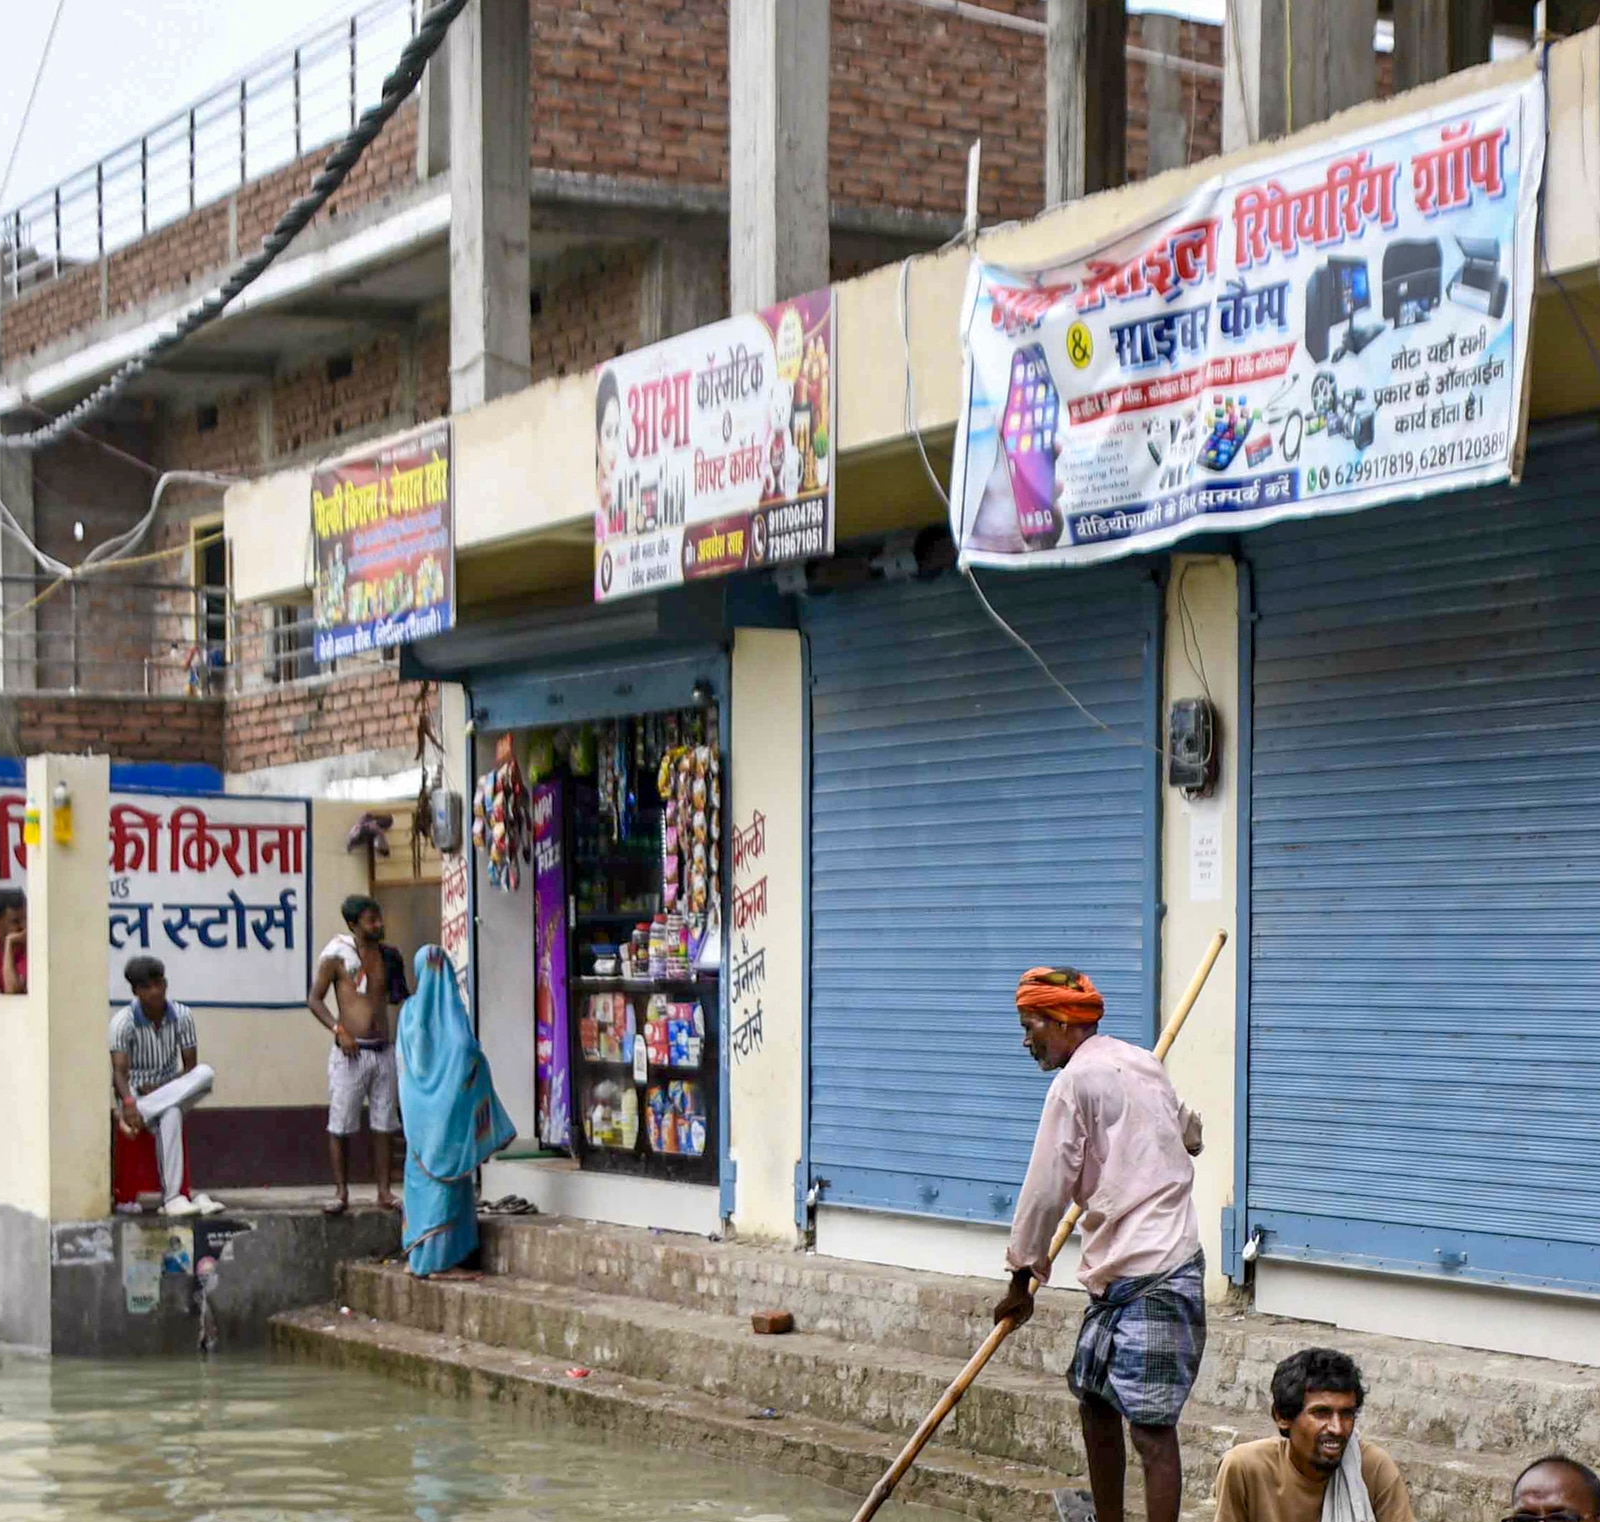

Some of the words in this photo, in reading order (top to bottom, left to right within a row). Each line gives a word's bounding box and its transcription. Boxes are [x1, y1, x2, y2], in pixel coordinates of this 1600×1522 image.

[1231, 150, 1399, 270] रिपेयरिंग
[1410, 120, 1510, 216] शॉप
[625, 369, 693, 459] आभा
[167, 804, 306, 879] किराना
[162, 888, 298, 951] स्टोर्स
